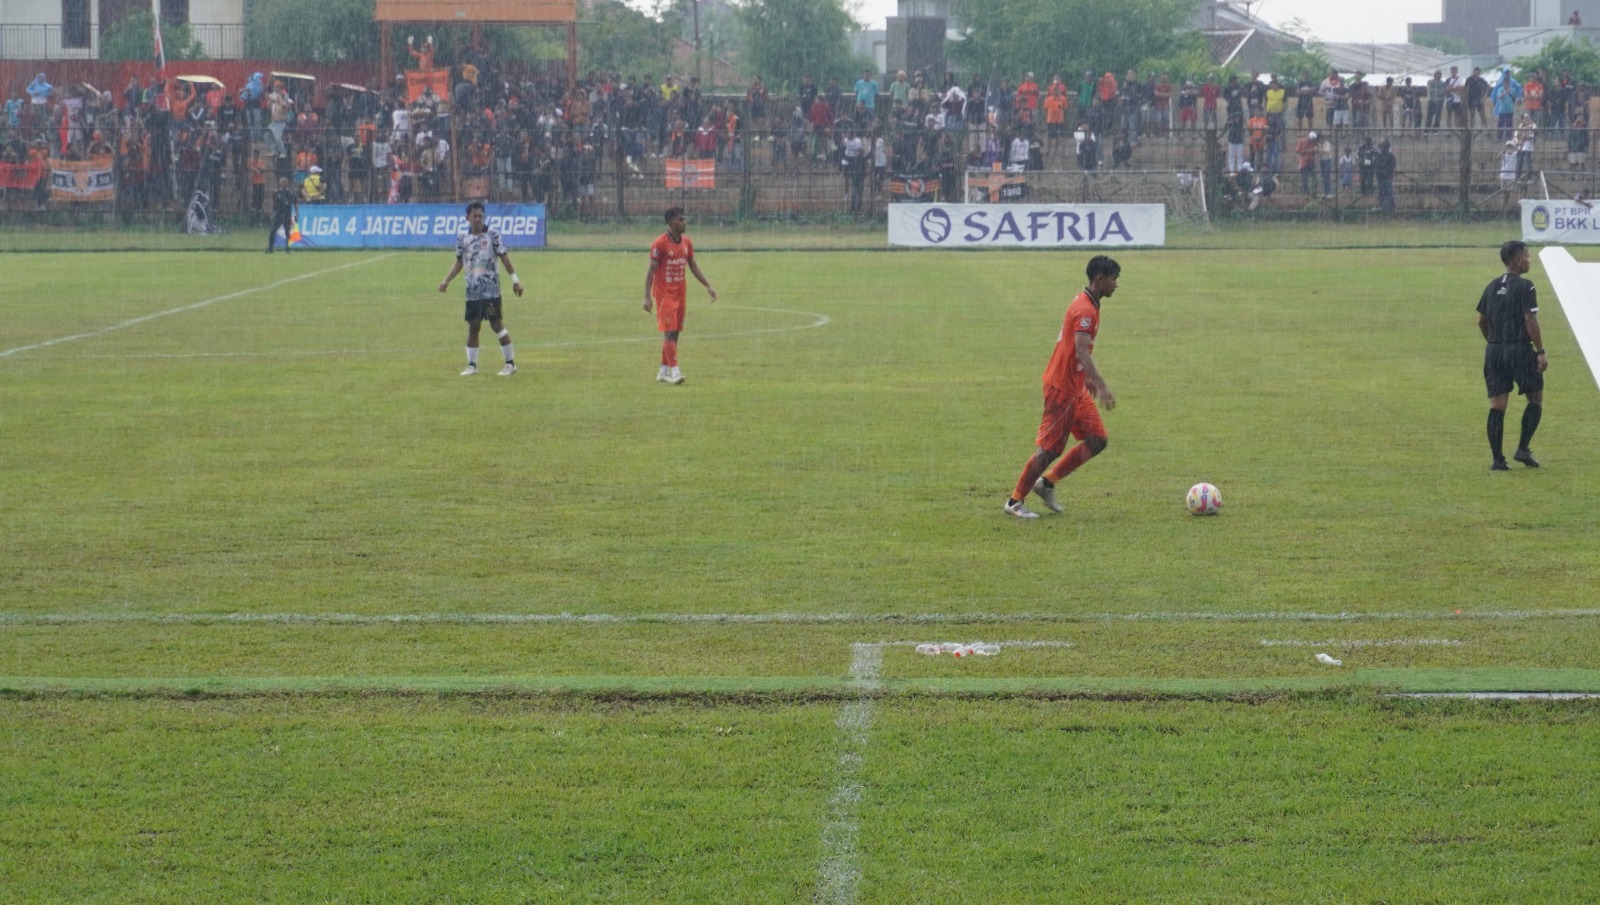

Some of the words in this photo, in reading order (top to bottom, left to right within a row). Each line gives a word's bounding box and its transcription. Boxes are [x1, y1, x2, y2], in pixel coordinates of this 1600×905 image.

[1555, 207, 1567, 216] PT
[1570, 207, 1591, 216] BPR
[302, 217, 340, 235] LIGA
[345, 217, 357, 234] 4
[361, 215, 429, 235] JATENG
[433, 216, 538, 235] 202/2026
[963, 210, 1134, 243] SAFRIA
[1555, 218, 1588, 230] BKK
